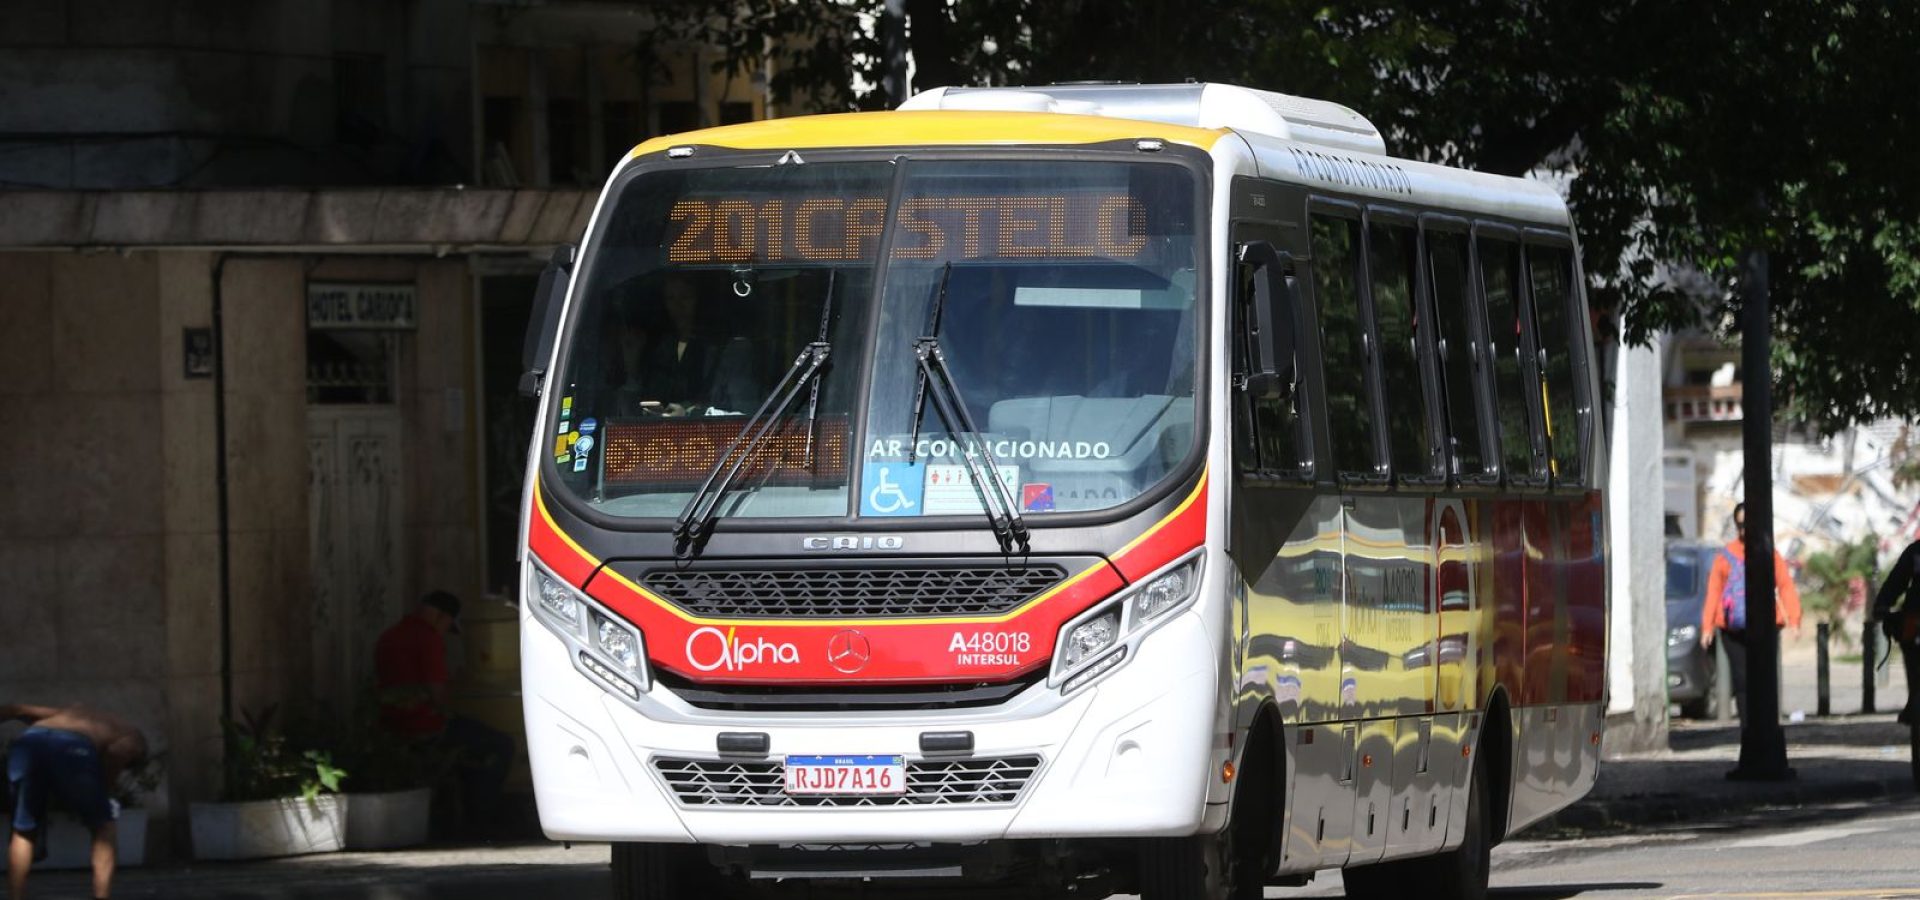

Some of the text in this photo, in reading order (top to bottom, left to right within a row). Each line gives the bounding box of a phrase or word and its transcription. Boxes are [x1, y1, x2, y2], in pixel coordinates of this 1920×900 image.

[670, 197, 1146, 261] 201 CASTELO
[310, 291, 352, 321] HOTEL
[870, 440, 902, 457] AR
[803, 536, 904, 550] CAIO
[948, 631, 1031, 652] A48018
[957, 653, 1020, 665] INTERSUL
[796, 767, 892, 789] RJD7A16
